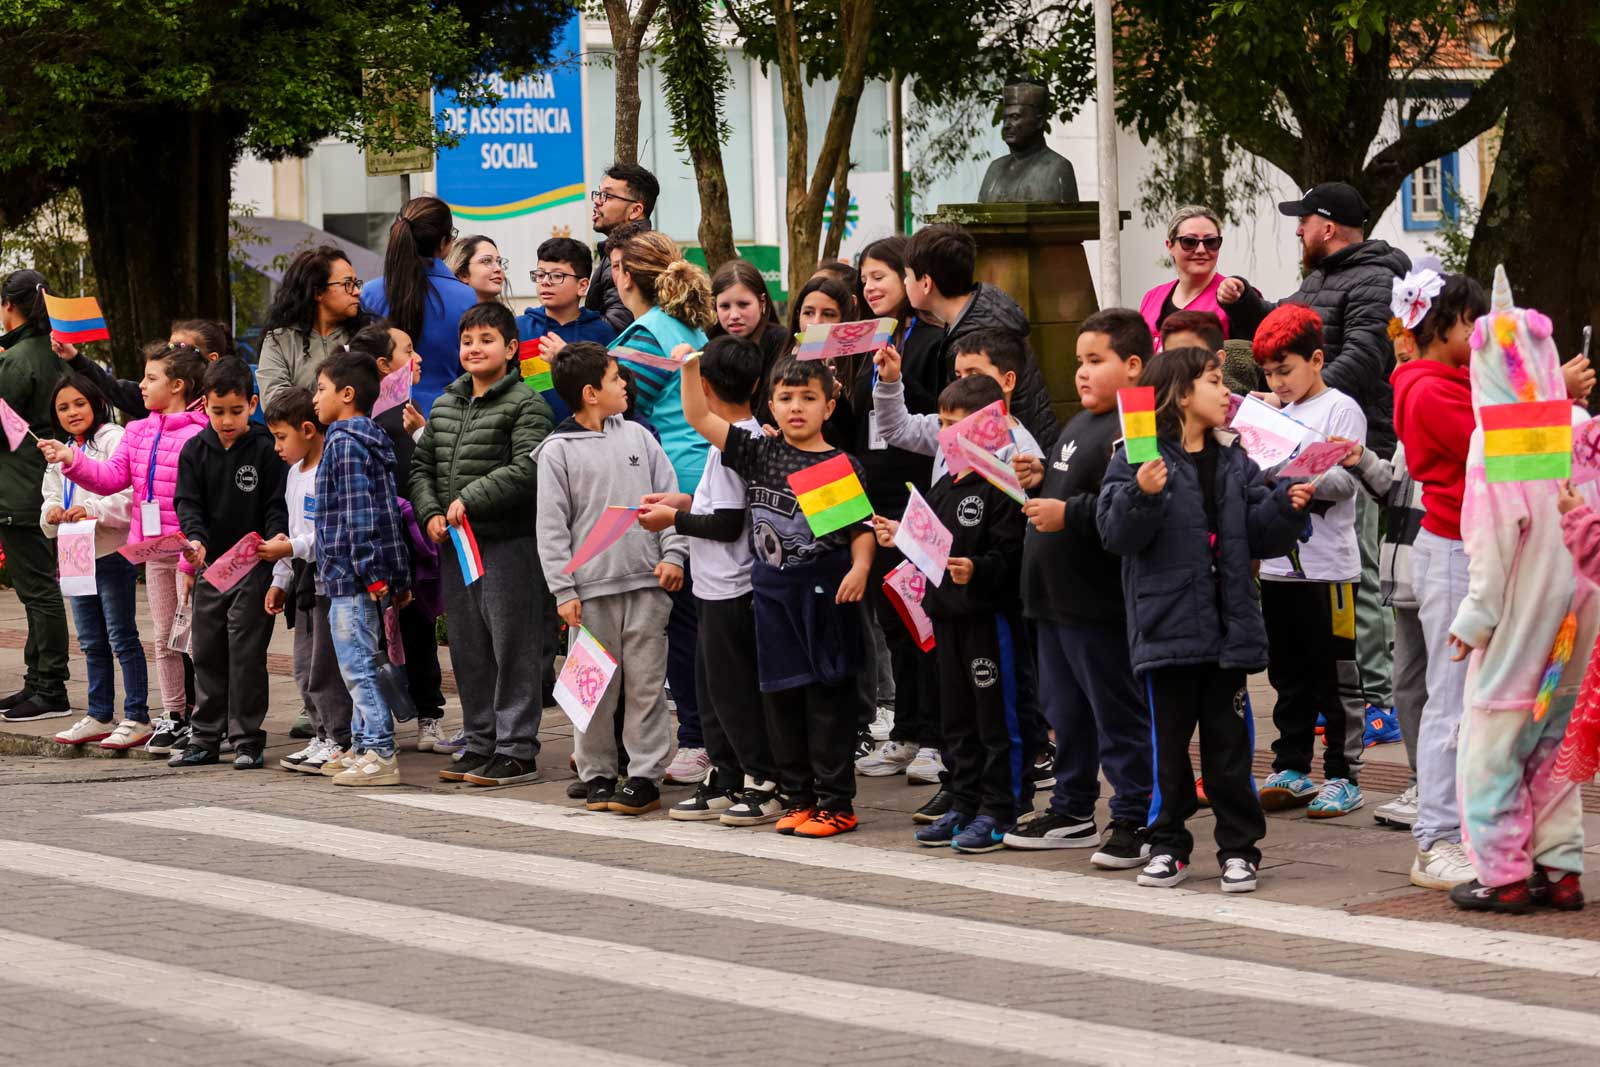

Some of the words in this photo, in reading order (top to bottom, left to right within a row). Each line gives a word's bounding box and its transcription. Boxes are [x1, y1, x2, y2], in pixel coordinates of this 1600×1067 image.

[444, 107, 467, 134] DE
[469, 102, 571, 134] ASSISTÊNCIA
[481, 142, 538, 169] SOCIAL
